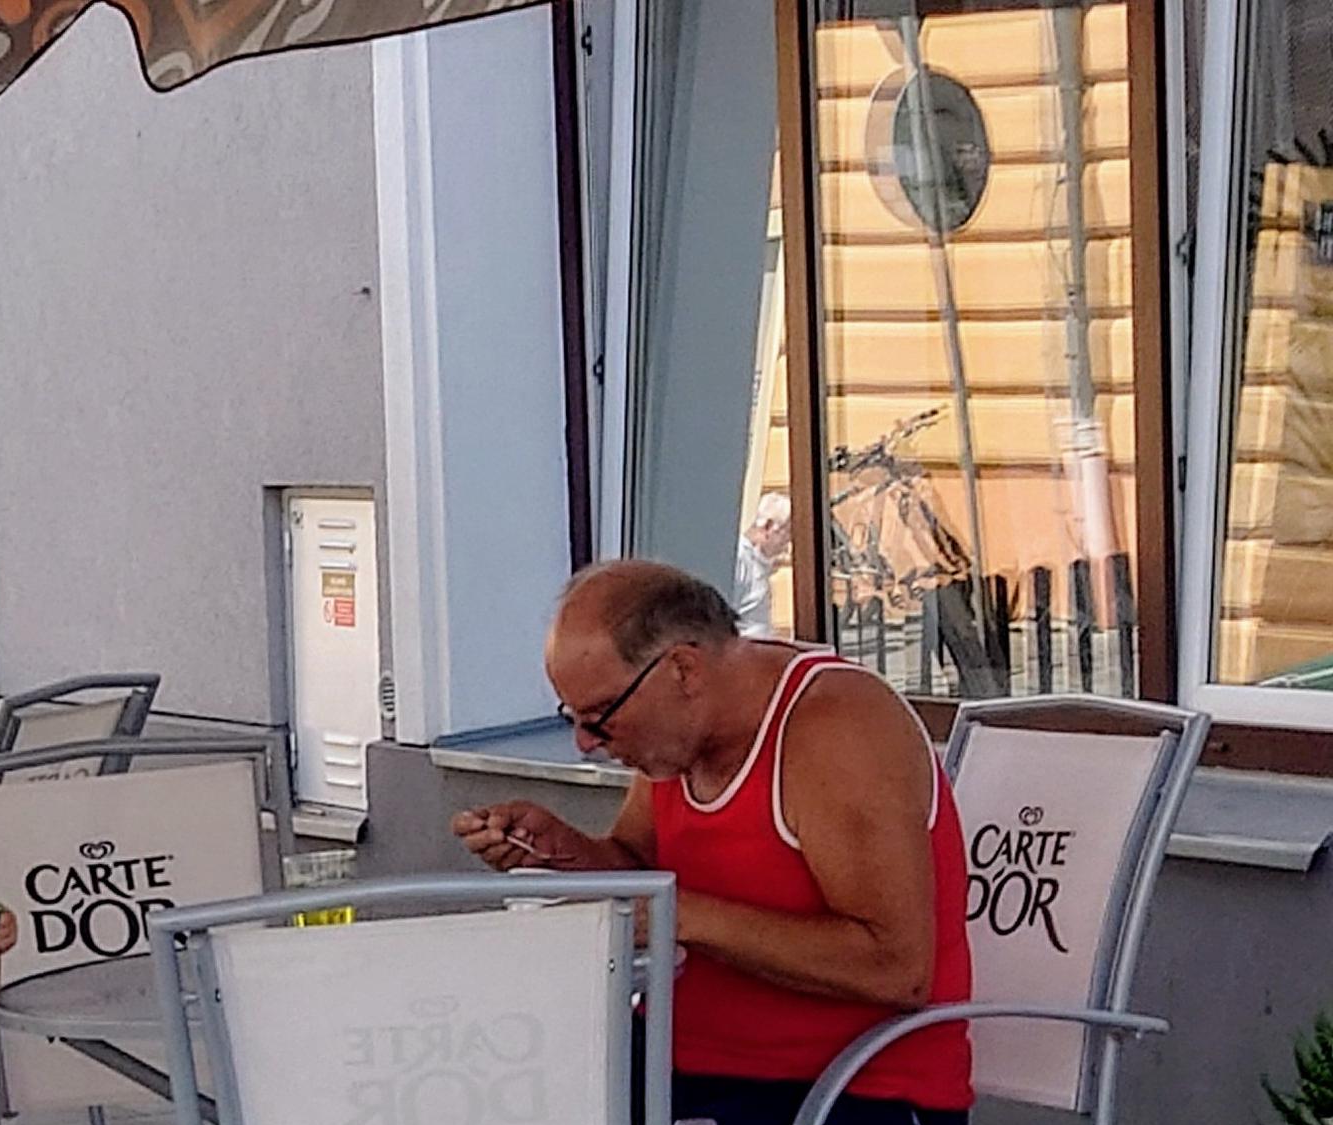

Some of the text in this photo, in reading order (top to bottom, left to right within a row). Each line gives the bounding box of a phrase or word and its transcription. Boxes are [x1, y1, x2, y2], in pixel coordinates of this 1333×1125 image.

[970, 824, 1071, 874] CARTE
[25, 855, 172, 905] CARTE
[966, 866, 1069, 953] D'OR
